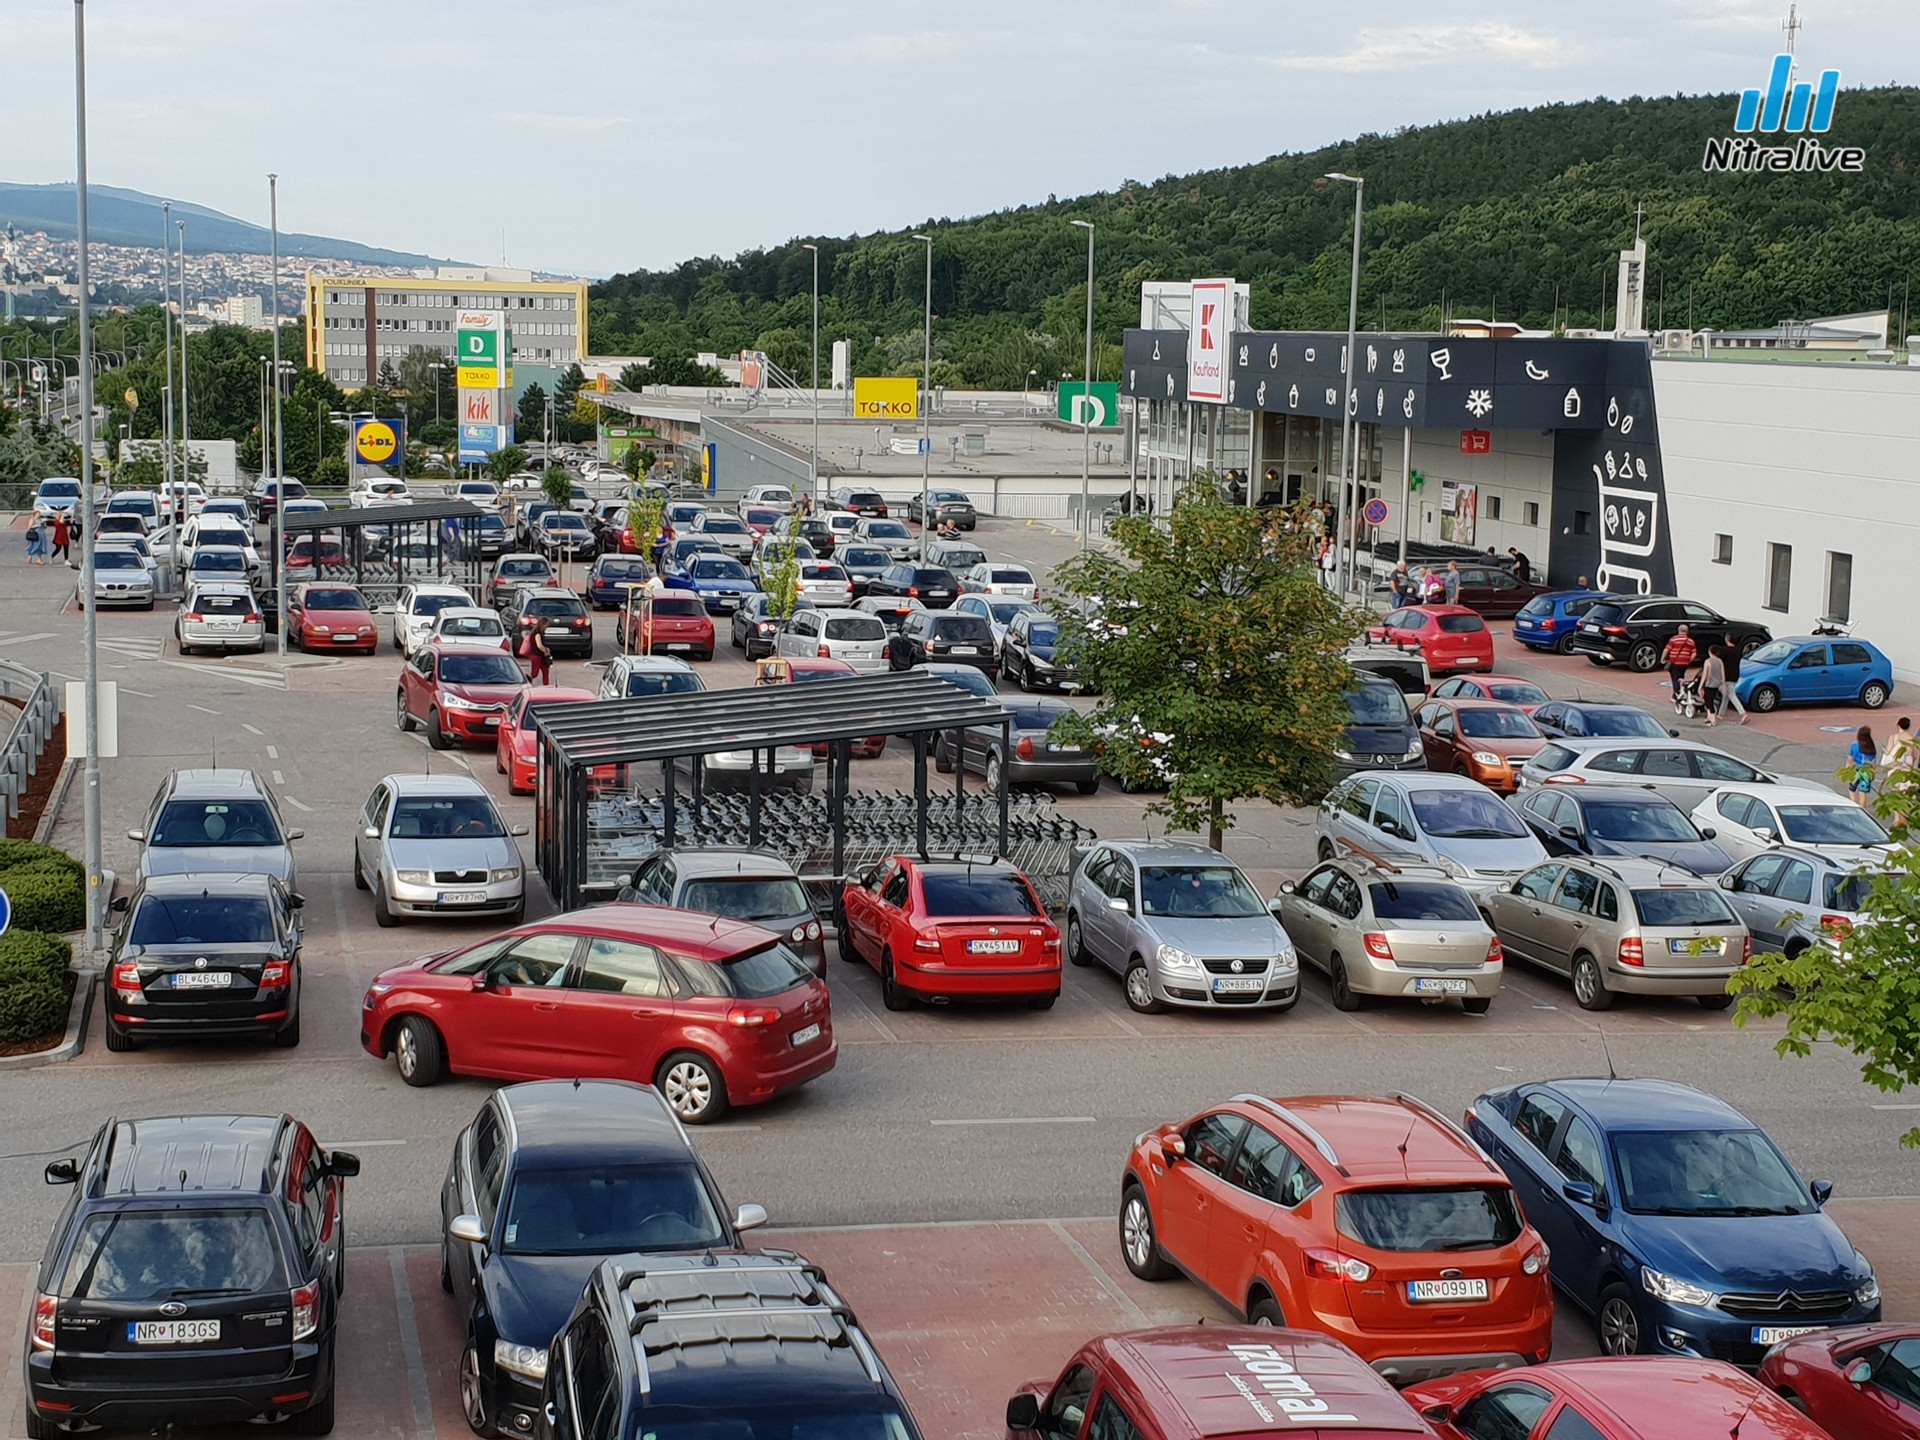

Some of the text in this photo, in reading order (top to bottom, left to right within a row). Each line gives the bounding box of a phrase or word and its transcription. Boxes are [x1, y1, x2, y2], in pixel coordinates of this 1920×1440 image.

[460, 313, 489, 326] Family
[470, 336, 484, 354] D
[1071, 395, 1105, 427] D
[359, 435, 393, 446] LIDL
